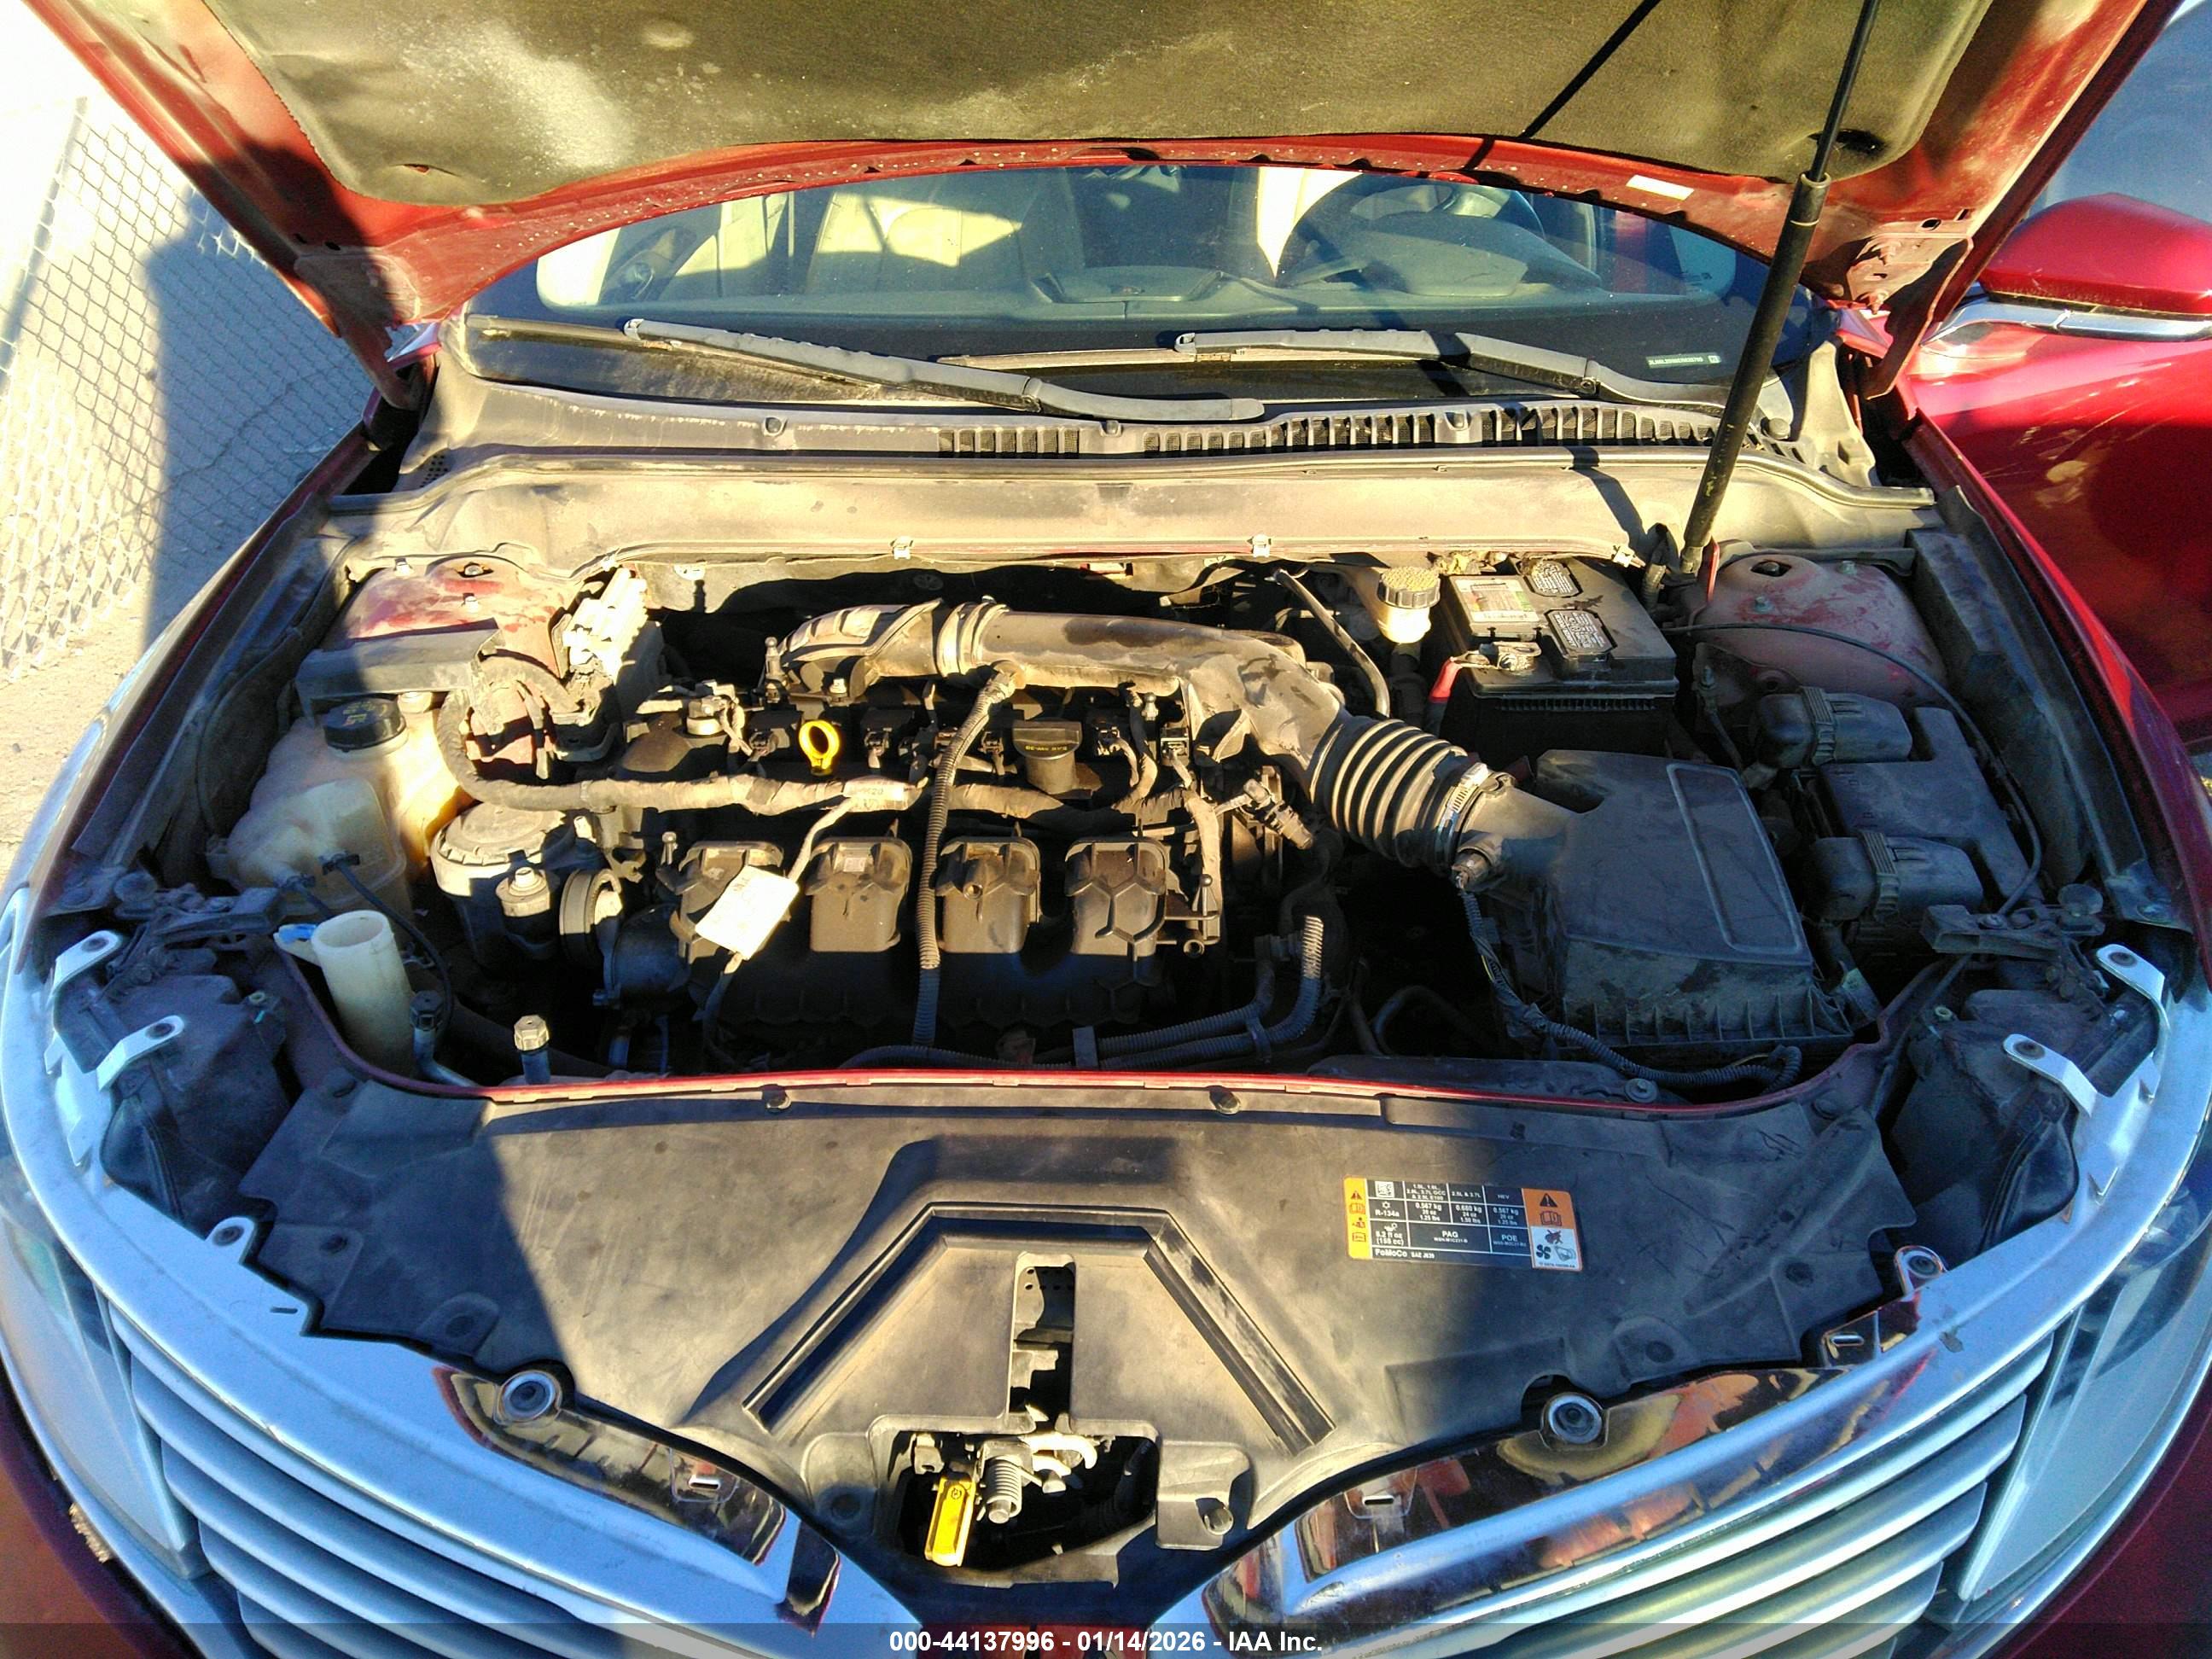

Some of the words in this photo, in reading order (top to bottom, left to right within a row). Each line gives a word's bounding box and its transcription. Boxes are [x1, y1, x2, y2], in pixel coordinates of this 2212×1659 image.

[1433, 1203, 1442, 1212] kg
[1473, 1205, 1482, 1214] kg
[1510, 1208, 1519, 1216] kg
[1375, 1208, 1400, 1217] R-134a
[1441, 1230, 1458, 1238] PAG
[1501, 1234, 1518, 1243] POE
[1375, 1248, 1408, 1258] FoMoCo
